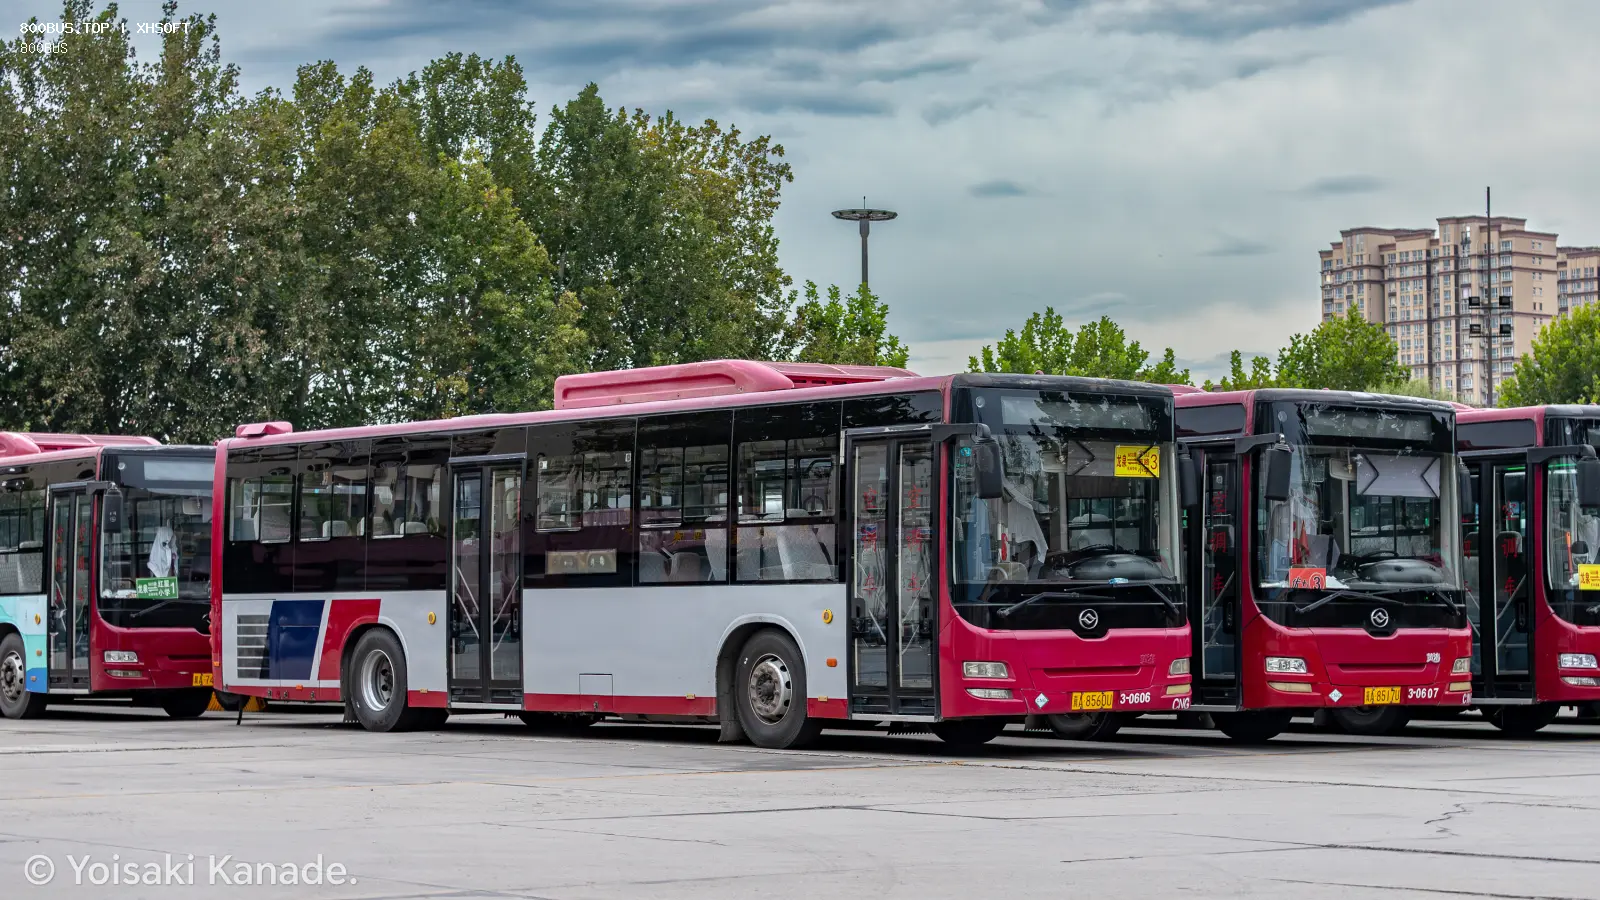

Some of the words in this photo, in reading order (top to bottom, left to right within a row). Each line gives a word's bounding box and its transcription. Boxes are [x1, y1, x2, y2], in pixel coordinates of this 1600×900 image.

[1150, 454, 1158, 470] 3
[1211, 491, 1227, 596] 空调车
[170, 582, 176, 595] 1
[1119, 692, 1151, 704] 3-0606
[1408, 687, 1439, 699] 3-0607
[1172, 697, 1190, 709] CNG
